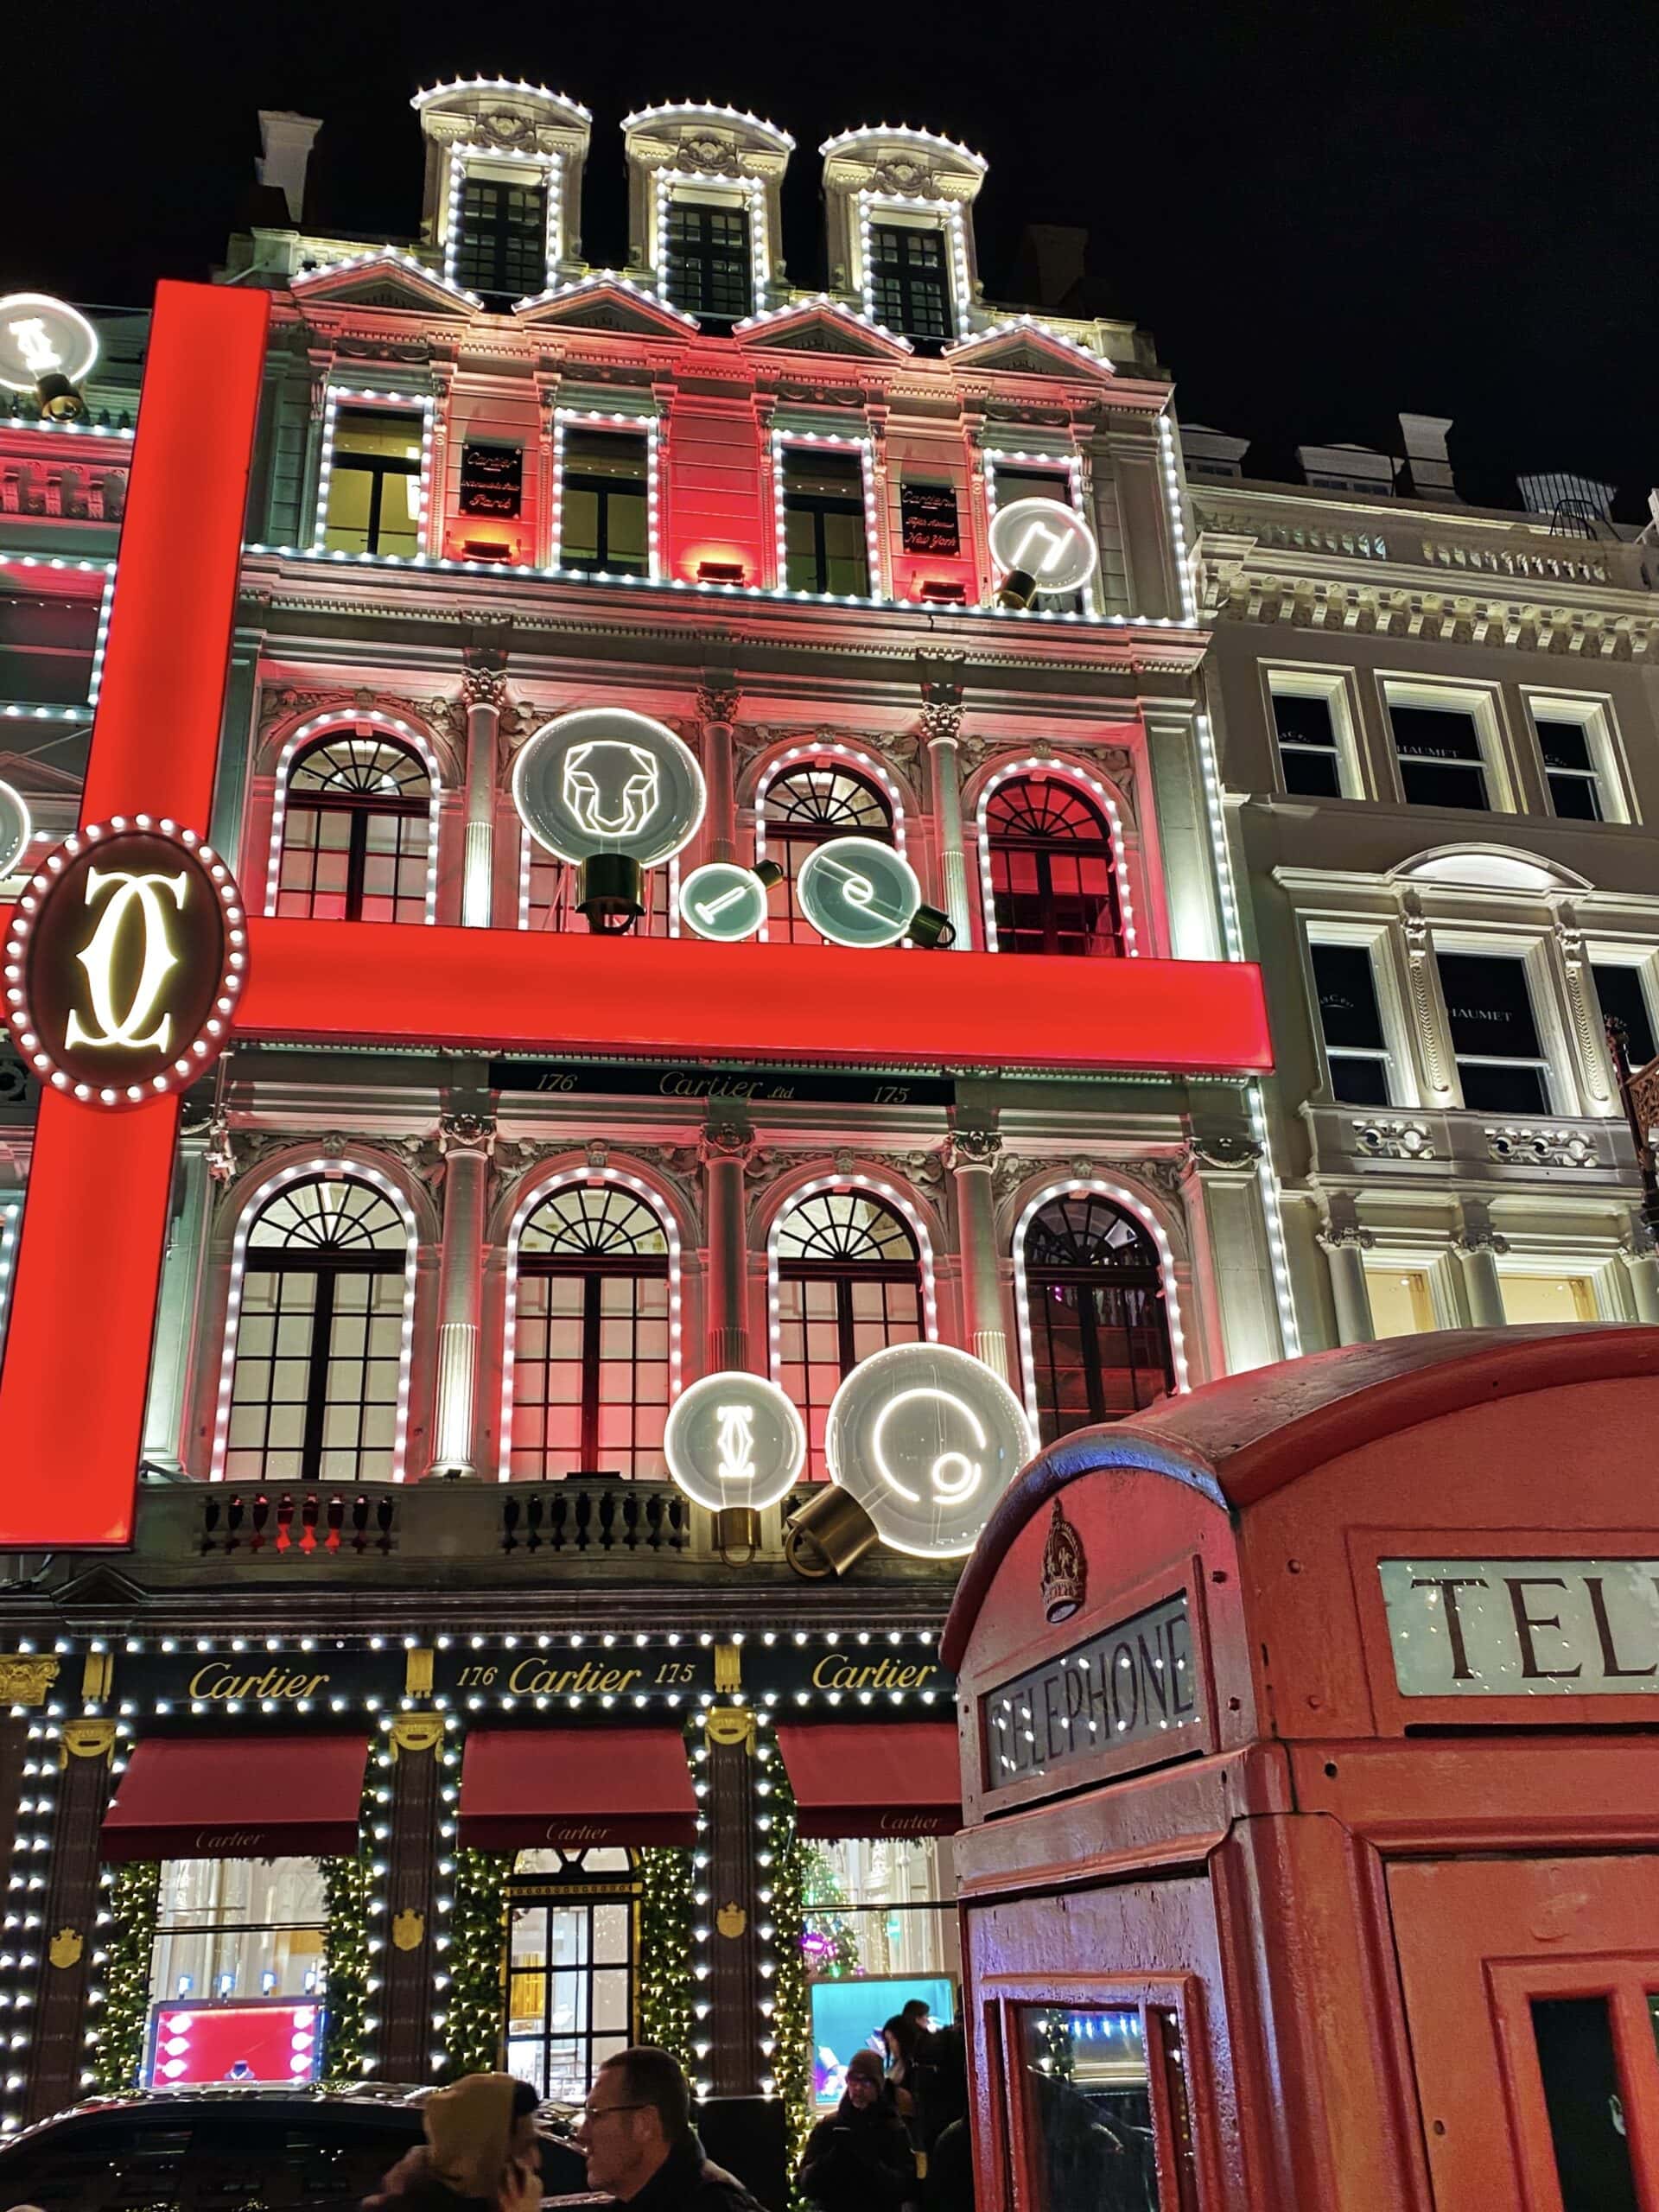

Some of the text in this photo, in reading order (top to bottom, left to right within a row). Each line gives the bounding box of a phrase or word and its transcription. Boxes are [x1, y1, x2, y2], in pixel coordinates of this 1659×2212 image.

[537, 1073, 578, 1091] 176
[659, 1071, 763, 1097] Cartier
[874, 1086, 911, 1103] 175
[1411, 1578, 1659, 1679] TEL
[189, 1662, 330, 1700] Cartier
[456, 1656, 696, 1694] 176 Cartier 175
[812, 1653, 938, 1689] Cartier
[994, 1612, 1194, 1777] TELEPHONE
[545, 1821, 610, 1840] Cartier
[880, 1812, 941, 1830] Cartier
[195, 1830, 266, 1849] Cartier
